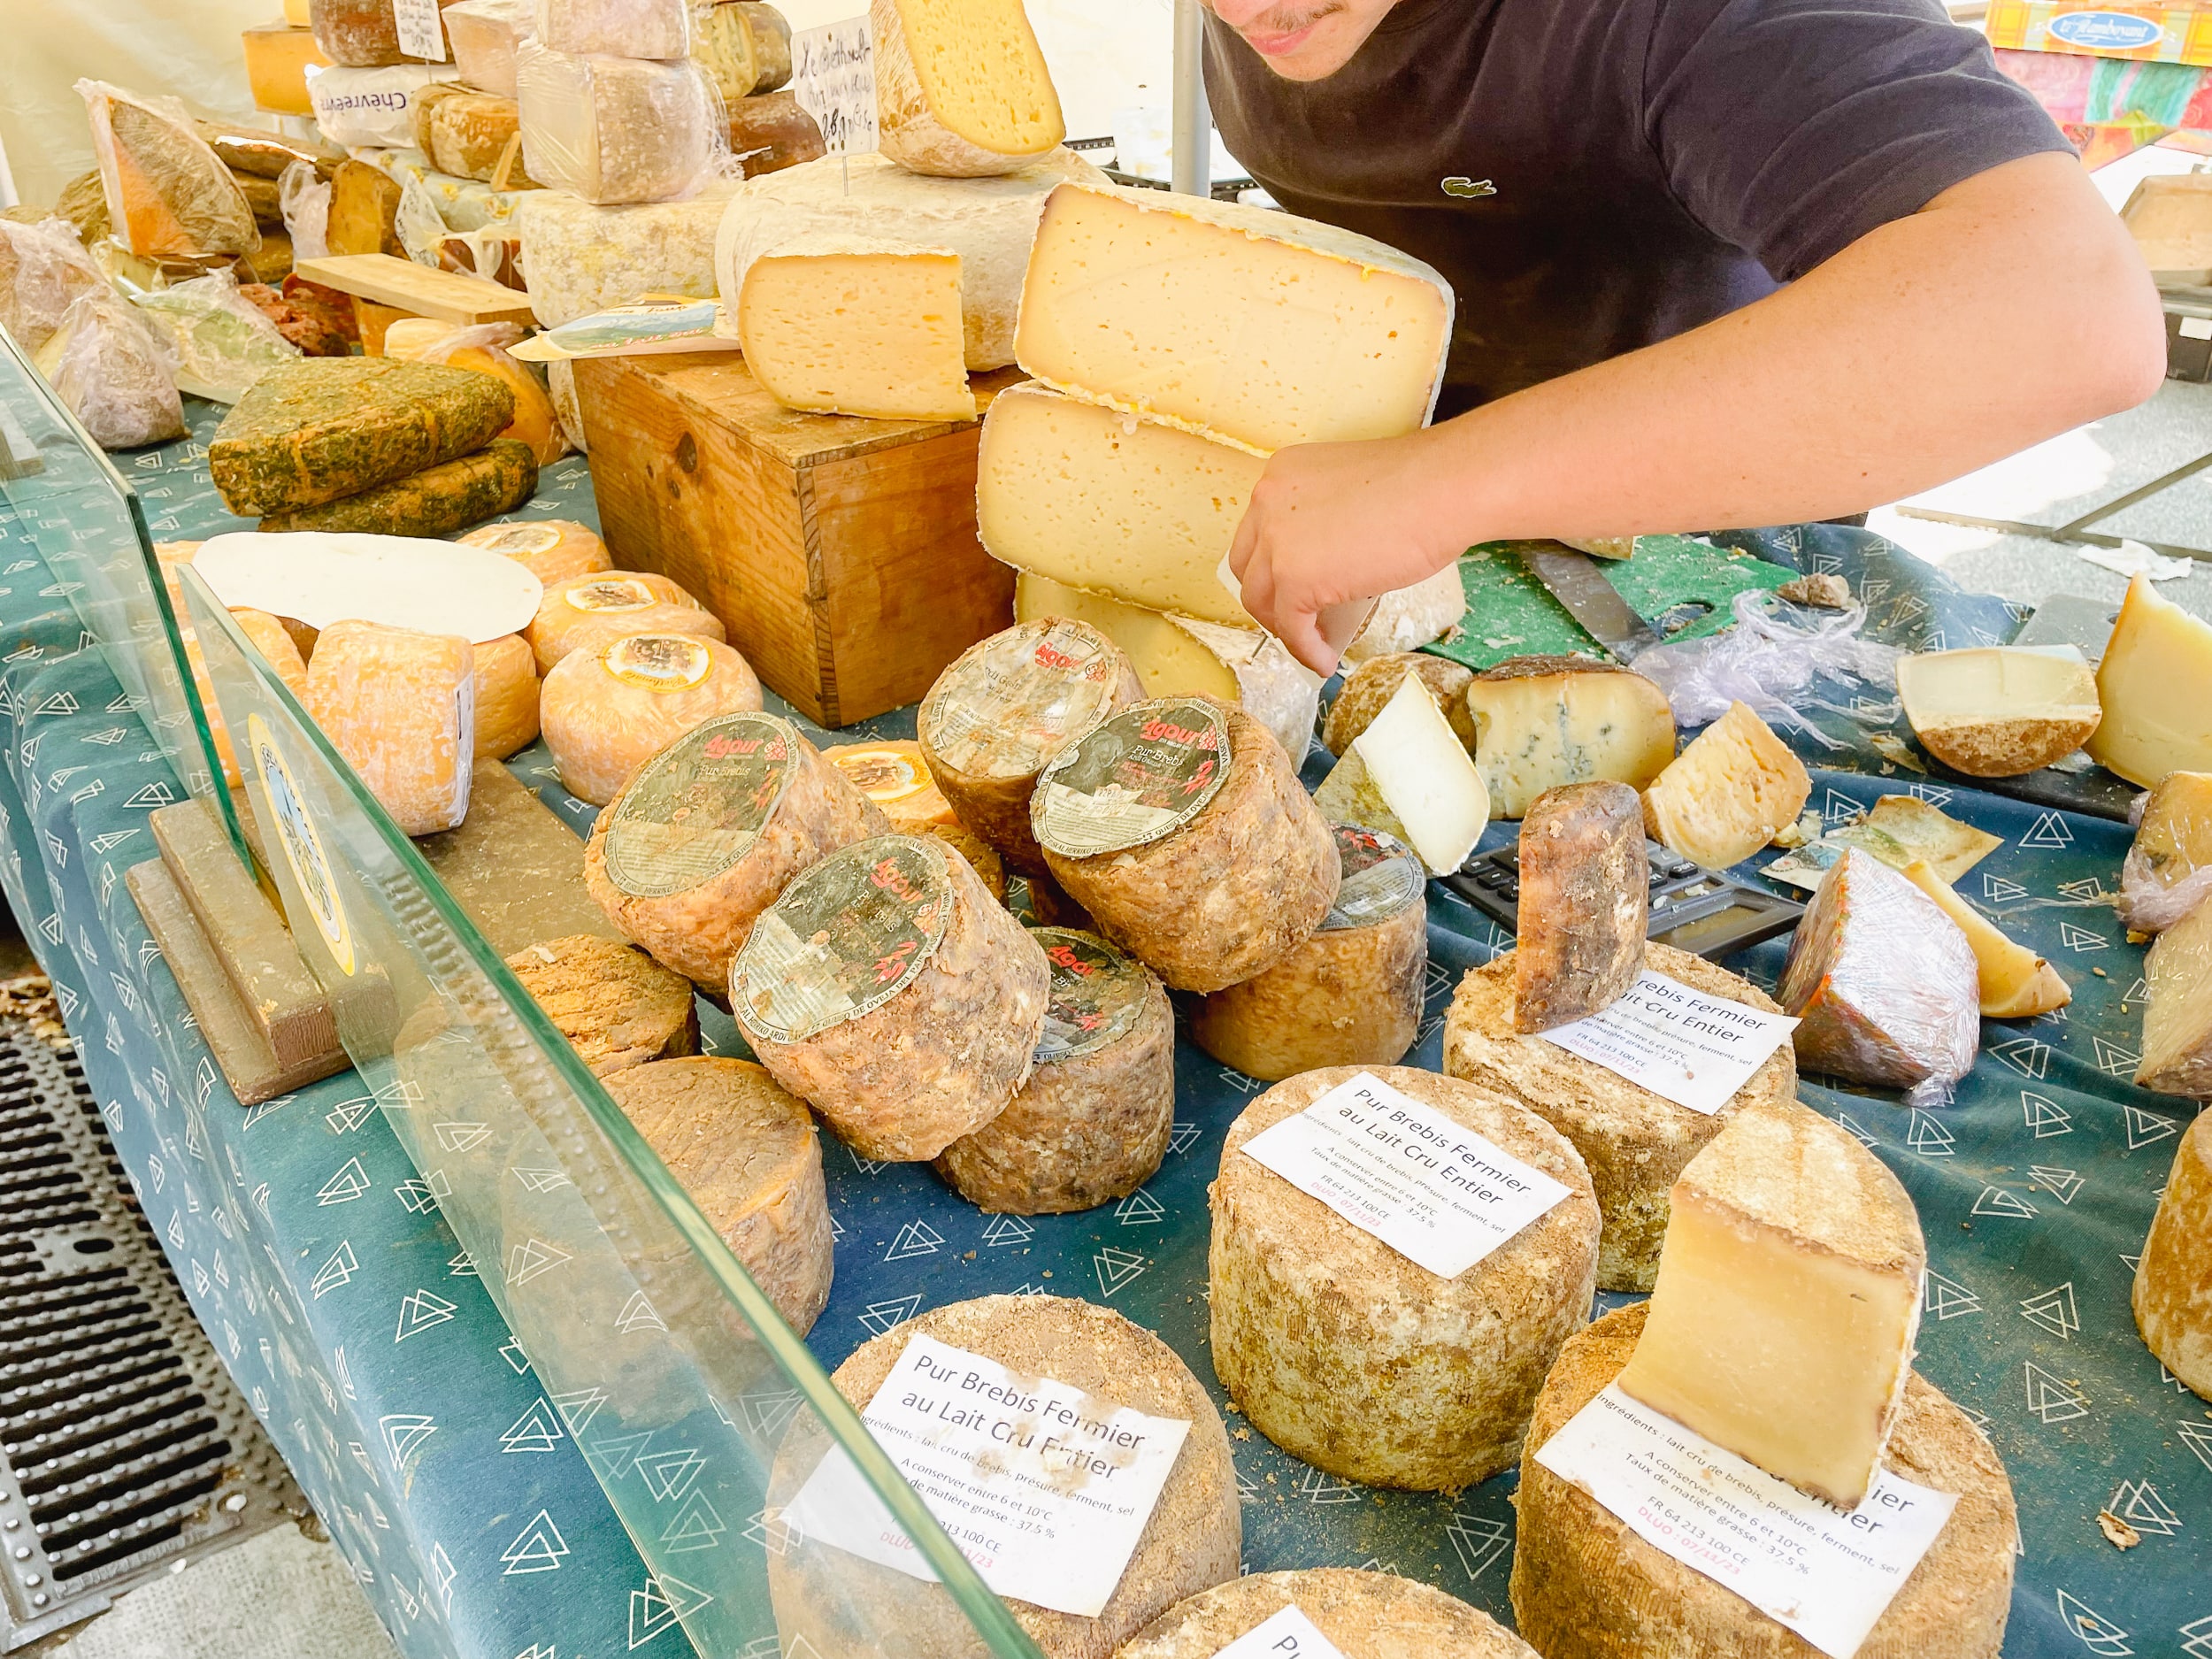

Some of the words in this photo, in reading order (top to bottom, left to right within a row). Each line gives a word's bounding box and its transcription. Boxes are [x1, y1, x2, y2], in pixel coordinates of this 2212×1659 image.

[703, 733, 764, 759] Agour
[852, 1006, 866, 1015] DE
[866, 988, 895, 1010] OVEJA
[895, 976, 910, 990] DEL
[1636, 979, 1685, 1002] rebis
[1686, 999, 1768, 1030] Fermier
[1645, 1002, 1679, 1021] Cru
[1682, 1017, 1744, 1042] Entier
[1618, 1050, 1635, 1062] 100
[1624, 1028, 1647, 1043] entre
[1661, 1030, 1696, 1048] présure,
[1699, 1044, 1736, 1063] ferment,
[1738, 1057, 1754, 1067] sel
[1339, 1107, 1365, 1125] au
[1365, 1123, 1403, 1148] Lait
[1404, 1145, 1440, 1169] Cru
[1440, 1165, 1504, 1203] Entier
[1354, 1089, 1389, 1111] Pur
[1389, 1110, 1449, 1148] Brebis
[1449, 1144, 1532, 1193] Fermier
[1310, 1147, 1330, 1162] Taux
[1341, 1168, 1374, 1188] matière
[1372, 1187, 1402, 1204] grasse
[1406, 1206, 1427, 1223] 37.5
[1310, 1181, 1337, 1197] DLUO
[1340, 1199, 1381, 1227] 07/11/23
[1320, 1174, 1333, 1184] FR
[1333, 1181, 1345, 1191] 64
[1344, 1189, 1362, 1202] 213
[1361, 1200, 1379, 1213] 100
[1378, 1210, 1392, 1220] CE
[1334, 1152, 1375, 1178] conserver
[1374, 1176, 1398, 1191] entre
[1416, 1201, 1438, 1217] 10°C
[1347, 1137, 1362, 1149] lait
[1360, 1148, 1375, 1157] cru
[1386, 1164, 1414, 1182] brebis,
[1415, 1179, 1448, 1204] présure,
[1451, 1202, 1488, 1226] ferment,
[1491, 1224, 1507, 1233] sel
[901, 1392, 934, 1414] au
[939, 1401, 987, 1432] Lait
[991, 1420, 1035, 1449] Cru
[913, 1355, 957, 1383] Pur
[960, 1371, 1039, 1413] Brebis
[1042, 1400, 1146, 1449] Fermier
[901, 1457, 910, 1467] A
[911, 1462, 966, 1490] conserver
[967, 1483, 998, 1502] entre
[1000, 1494, 1009, 1504] 6
[1010, 1500, 1023, 1511] et
[1024, 1505, 1054, 1521] 10°C
[910, 1477, 926, 1491] de
[926, 1486, 970, 1509] matière
[970, 1504, 1008, 1524] grasse
[1016, 1520, 1041, 1535] 37.5
[1044, 1528, 1055, 1540] %
[941, 1444, 958, 1456] cru
[960, 1451, 975, 1463] de
[1014, 1471, 1062, 1498] présure,
[1065, 1490, 1113, 1514] ferment,
[1117, 1506, 1135, 1517] sel
[1596, 1394, 1659, 1437] Ingrédients
[1666, 1437, 1686, 1453] lait
[1686, 1451, 1707, 1467] cru
[1707, 1464, 1723, 1477] de
[1724, 1473, 1763, 1503] brebis,
[1765, 1501, 1817, 1537] présure,
[1820, 1532, 1875, 1569] ferment,
[1878, 1563, 1901, 1575] sel
[1644, 1451, 1655, 1460] A
[1655, 1459, 1715, 1498] conserver
[1715, 1494, 1748, 1521] entre
[1749, 1517, 1759, 1527] 6
[1760, 1524, 1775, 1538] et
[1776, 1534, 1809, 1557] 10°C
[962, 1529, 985, 1545] 100
[985, 1539, 1002, 1553] CE
[1625, 1452, 1654, 1475] Taux
[1653, 1471, 1670, 1486] de
[1671, 1484, 1717, 1517] matière
[1716, 1516, 1758, 1545] grasse
[1766, 1544, 1797, 1567] 37.5
[1793, 1562, 1810, 1576] %
[1637, 1506, 1673, 1535] DLUO
[1680, 1537, 1742, 1576] 07/11/23
[1647, 1495, 1664, 1511] FR
[1663, 1508, 1682, 1524] 64
[1680, 1519, 1707, 1540] 213
[1706, 1537, 1733, 1555] 100
[1732, 1551, 1751, 1567] CE
